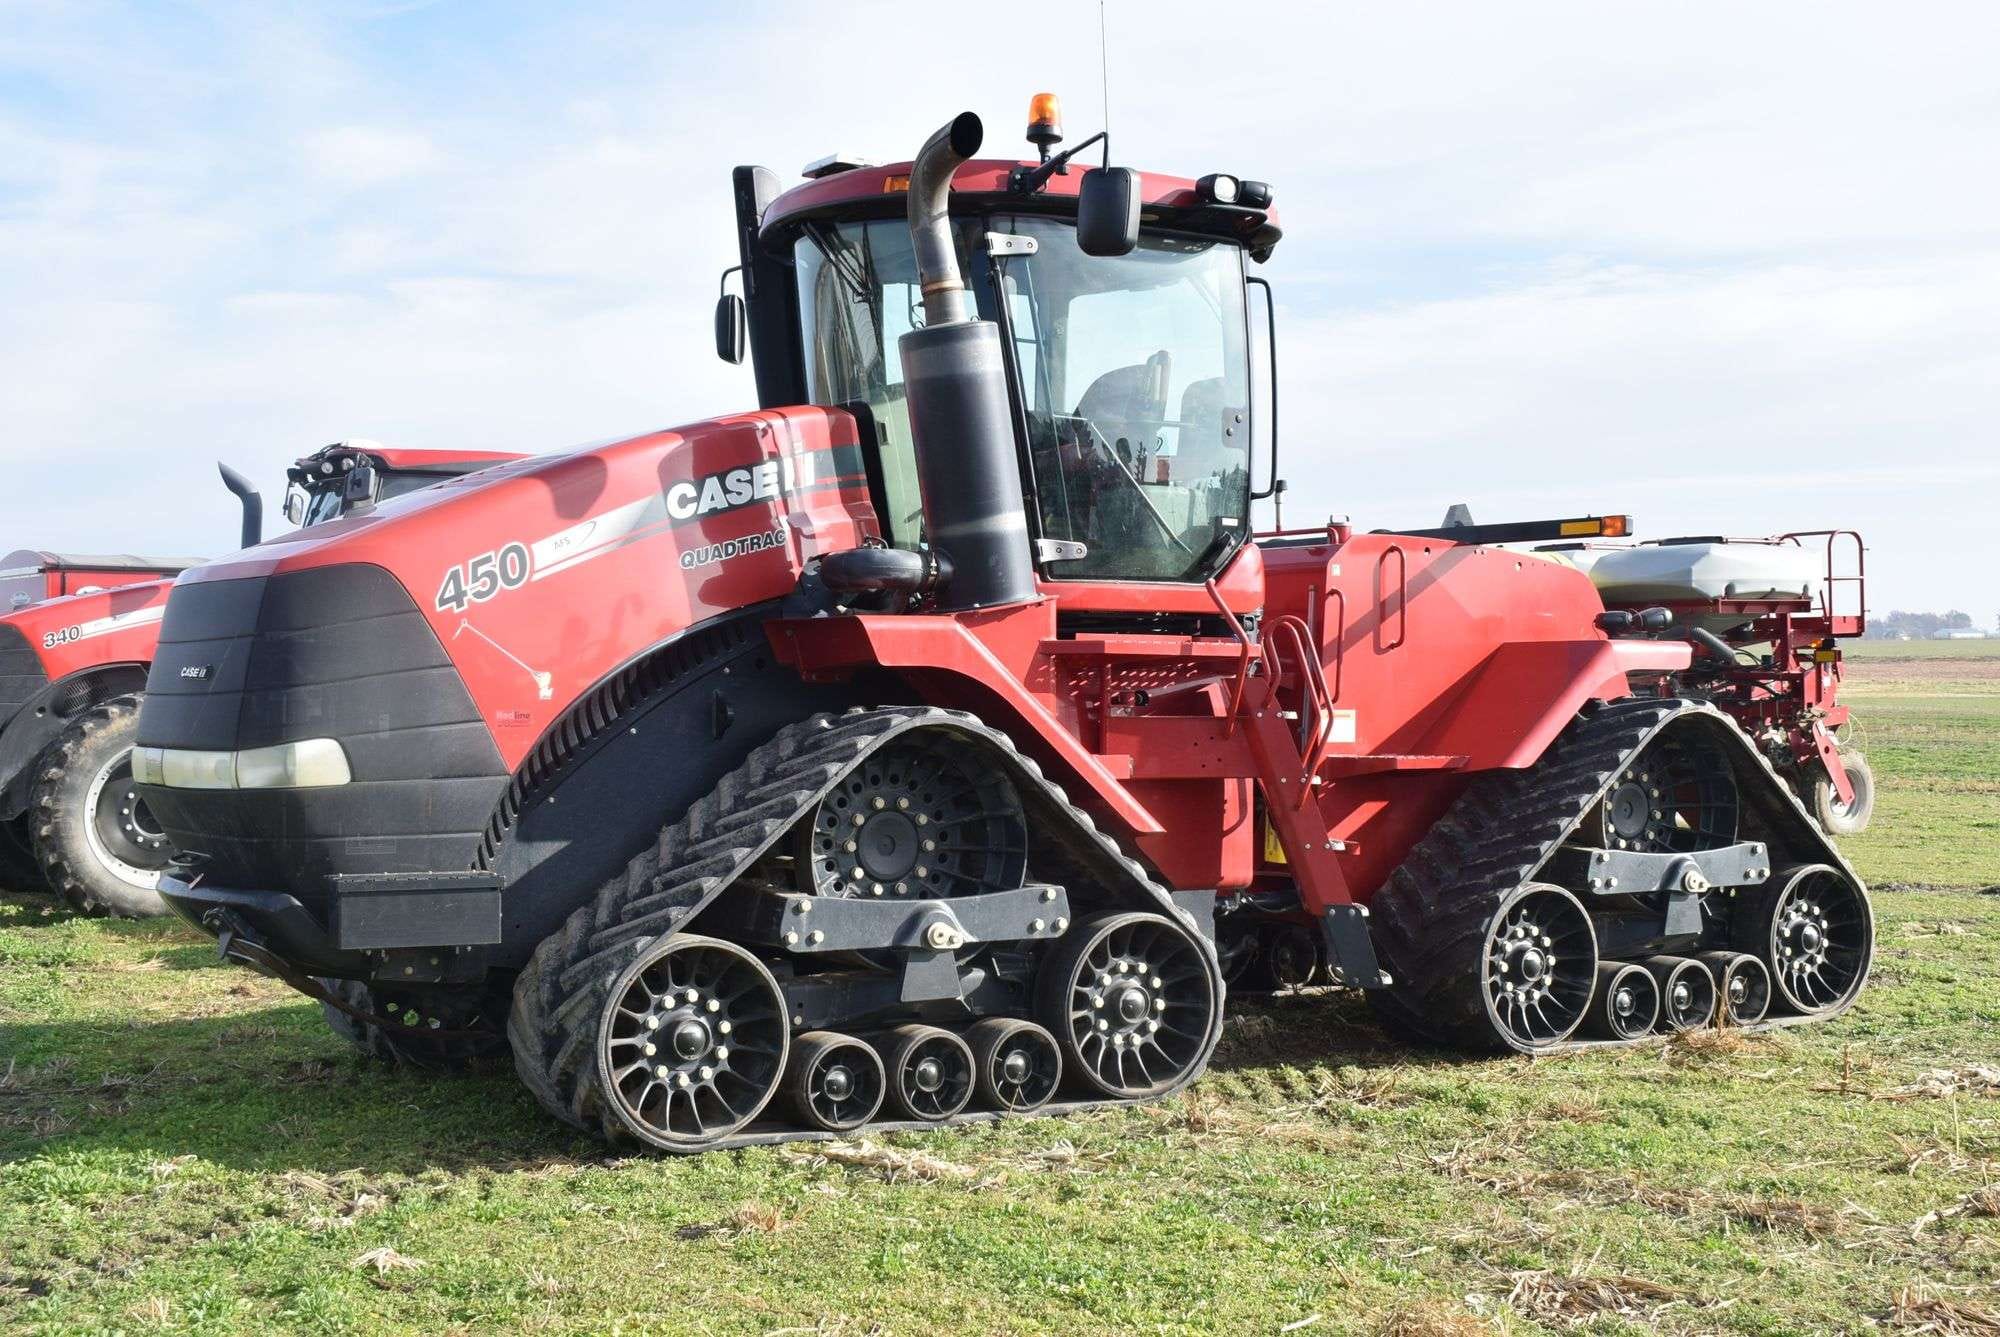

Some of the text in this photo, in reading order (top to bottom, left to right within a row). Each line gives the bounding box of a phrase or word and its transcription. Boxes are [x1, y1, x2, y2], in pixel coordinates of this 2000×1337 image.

[666, 460, 781, 520] CASE
[679, 527, 787, 569] QUADTRAC
[435, 541, 530, 613] 450
[43, 624, 82, 649] 340
